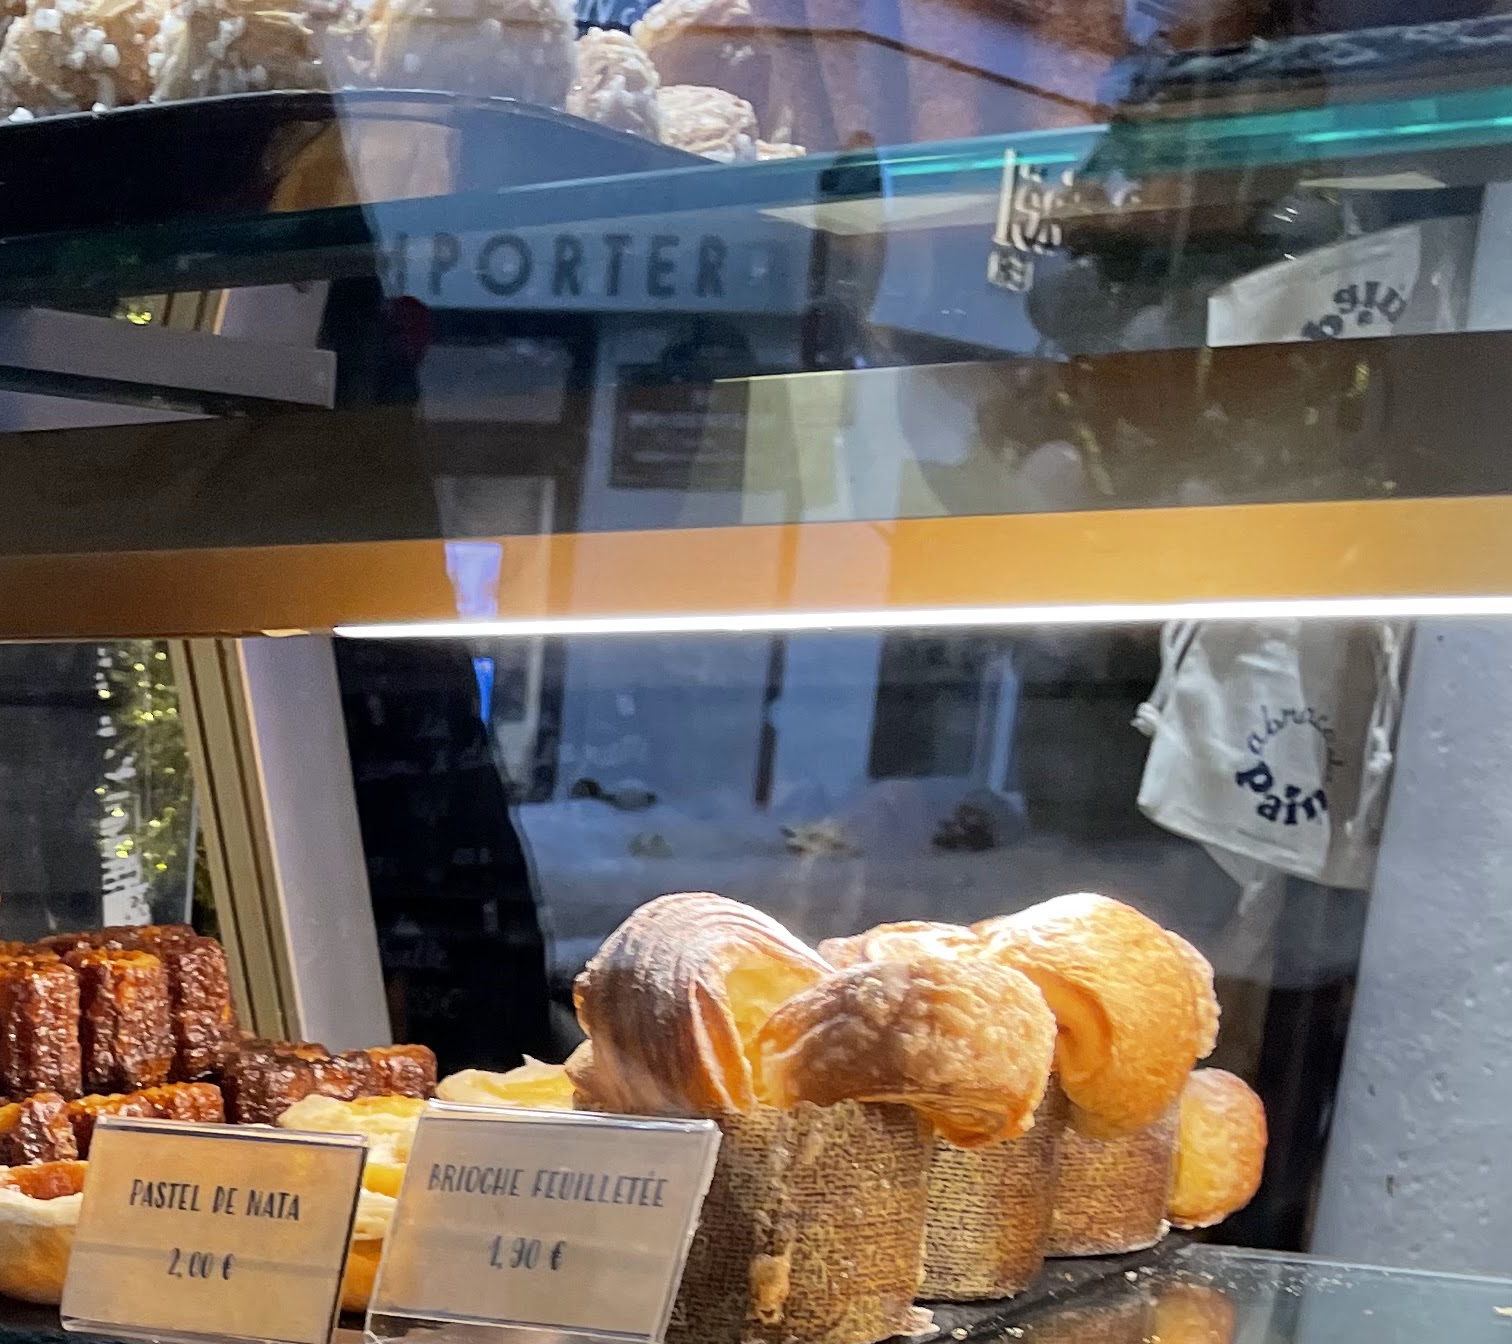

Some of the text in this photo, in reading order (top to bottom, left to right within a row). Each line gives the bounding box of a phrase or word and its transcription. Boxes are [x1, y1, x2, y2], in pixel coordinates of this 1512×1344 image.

[129, 1179, 300, 1221] PASTEL DE NATA
[427, 1162, 669, 1208] BRIOCHE FEUILLETÉE
[222, 1253, 236, 1281] €
[550, 1240, 567, 1271] €
